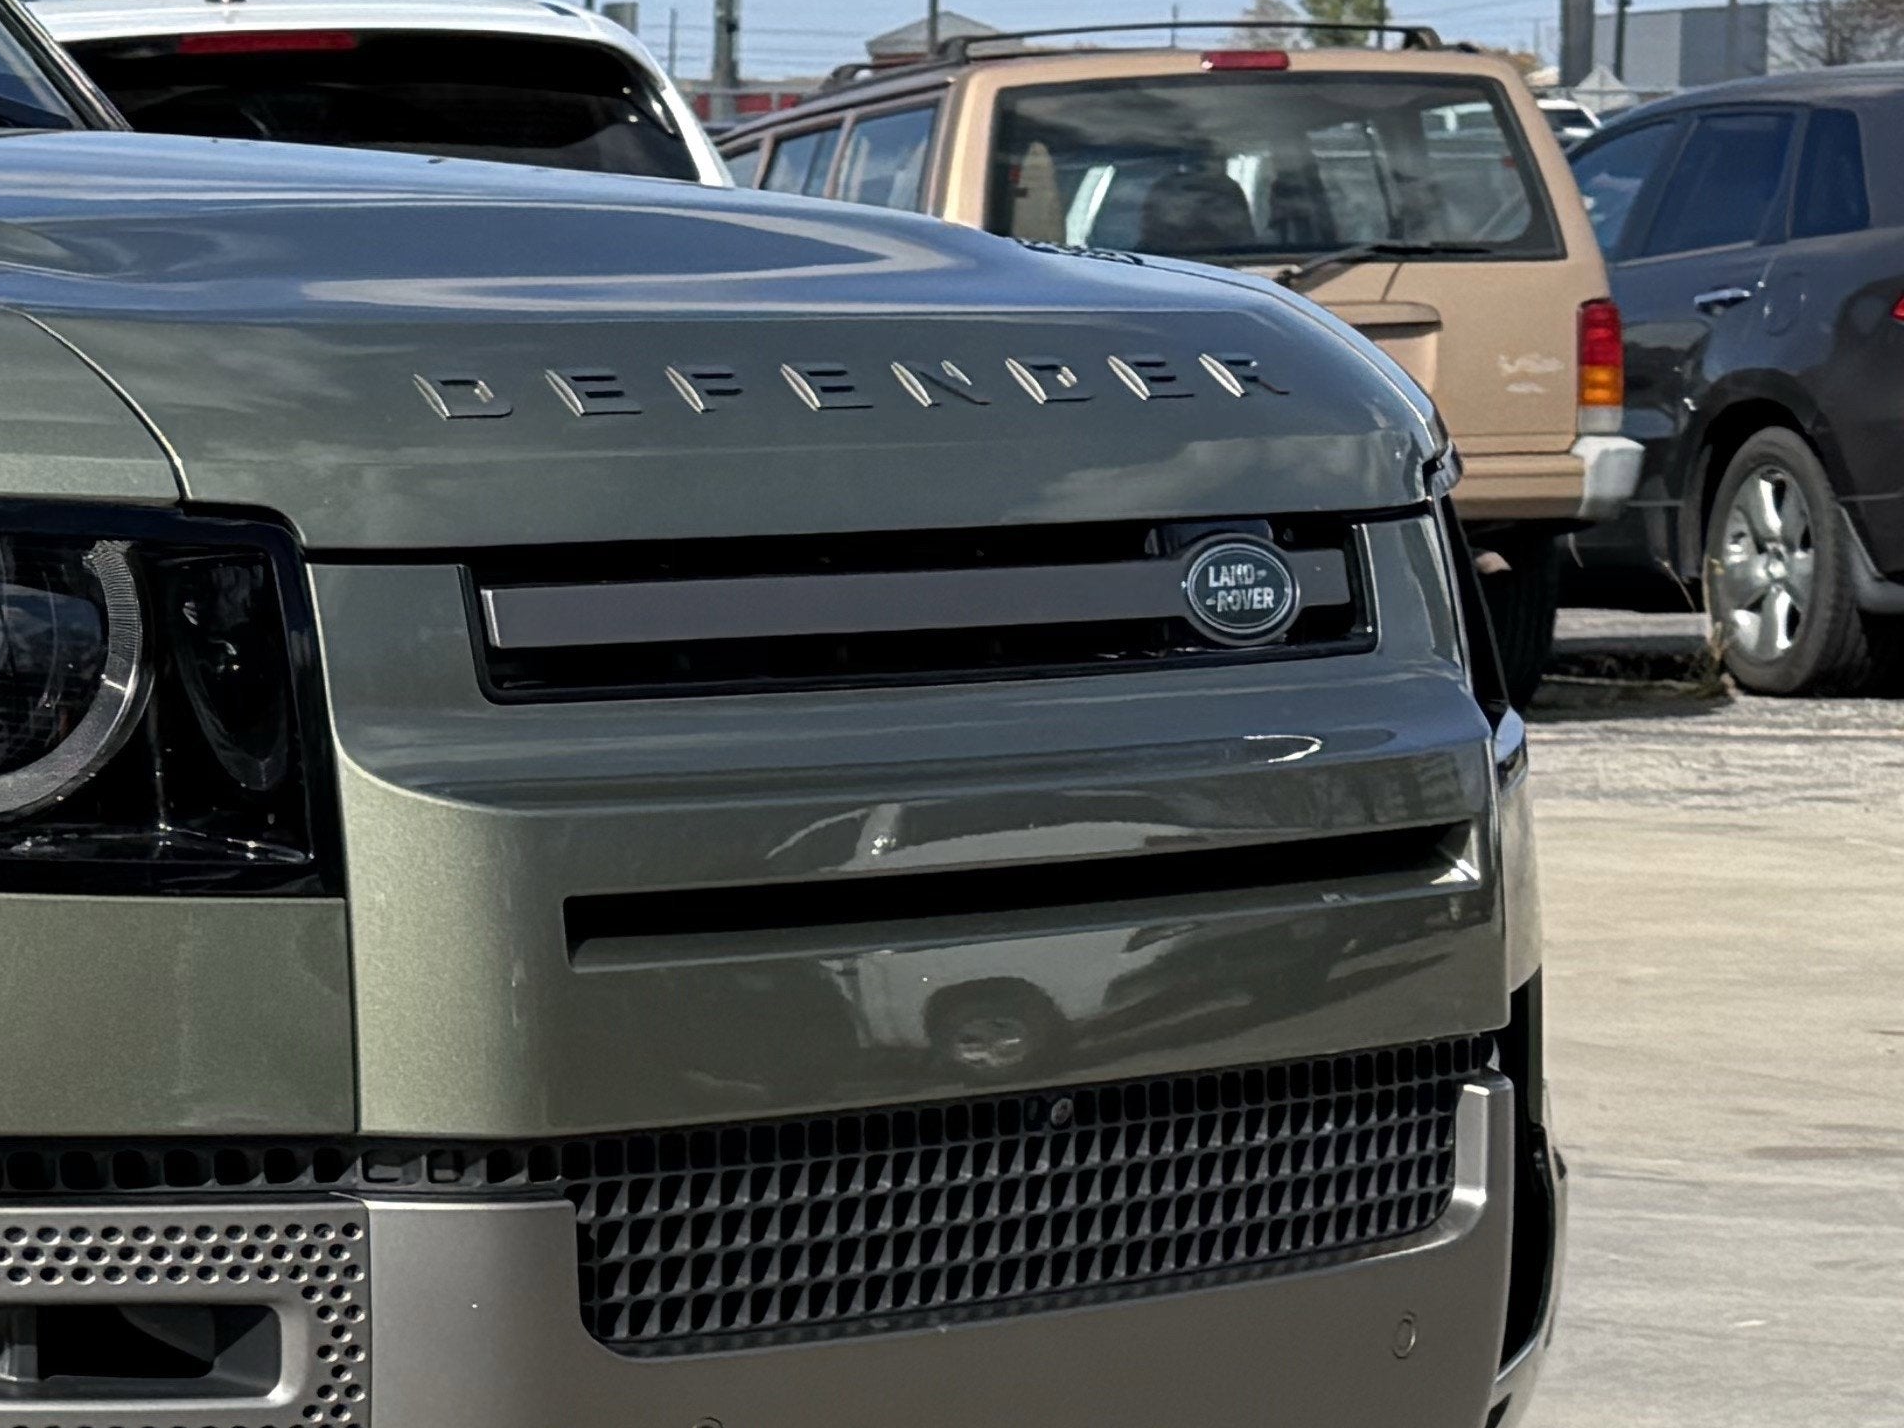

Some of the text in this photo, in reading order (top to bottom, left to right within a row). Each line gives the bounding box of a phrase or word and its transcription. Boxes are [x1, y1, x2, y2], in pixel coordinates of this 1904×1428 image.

[413, 351, 1292, 421] DEFENDER
[1208, 563, 1256, 587] LAND
[1216, 586, 1274, 613] ROVER
